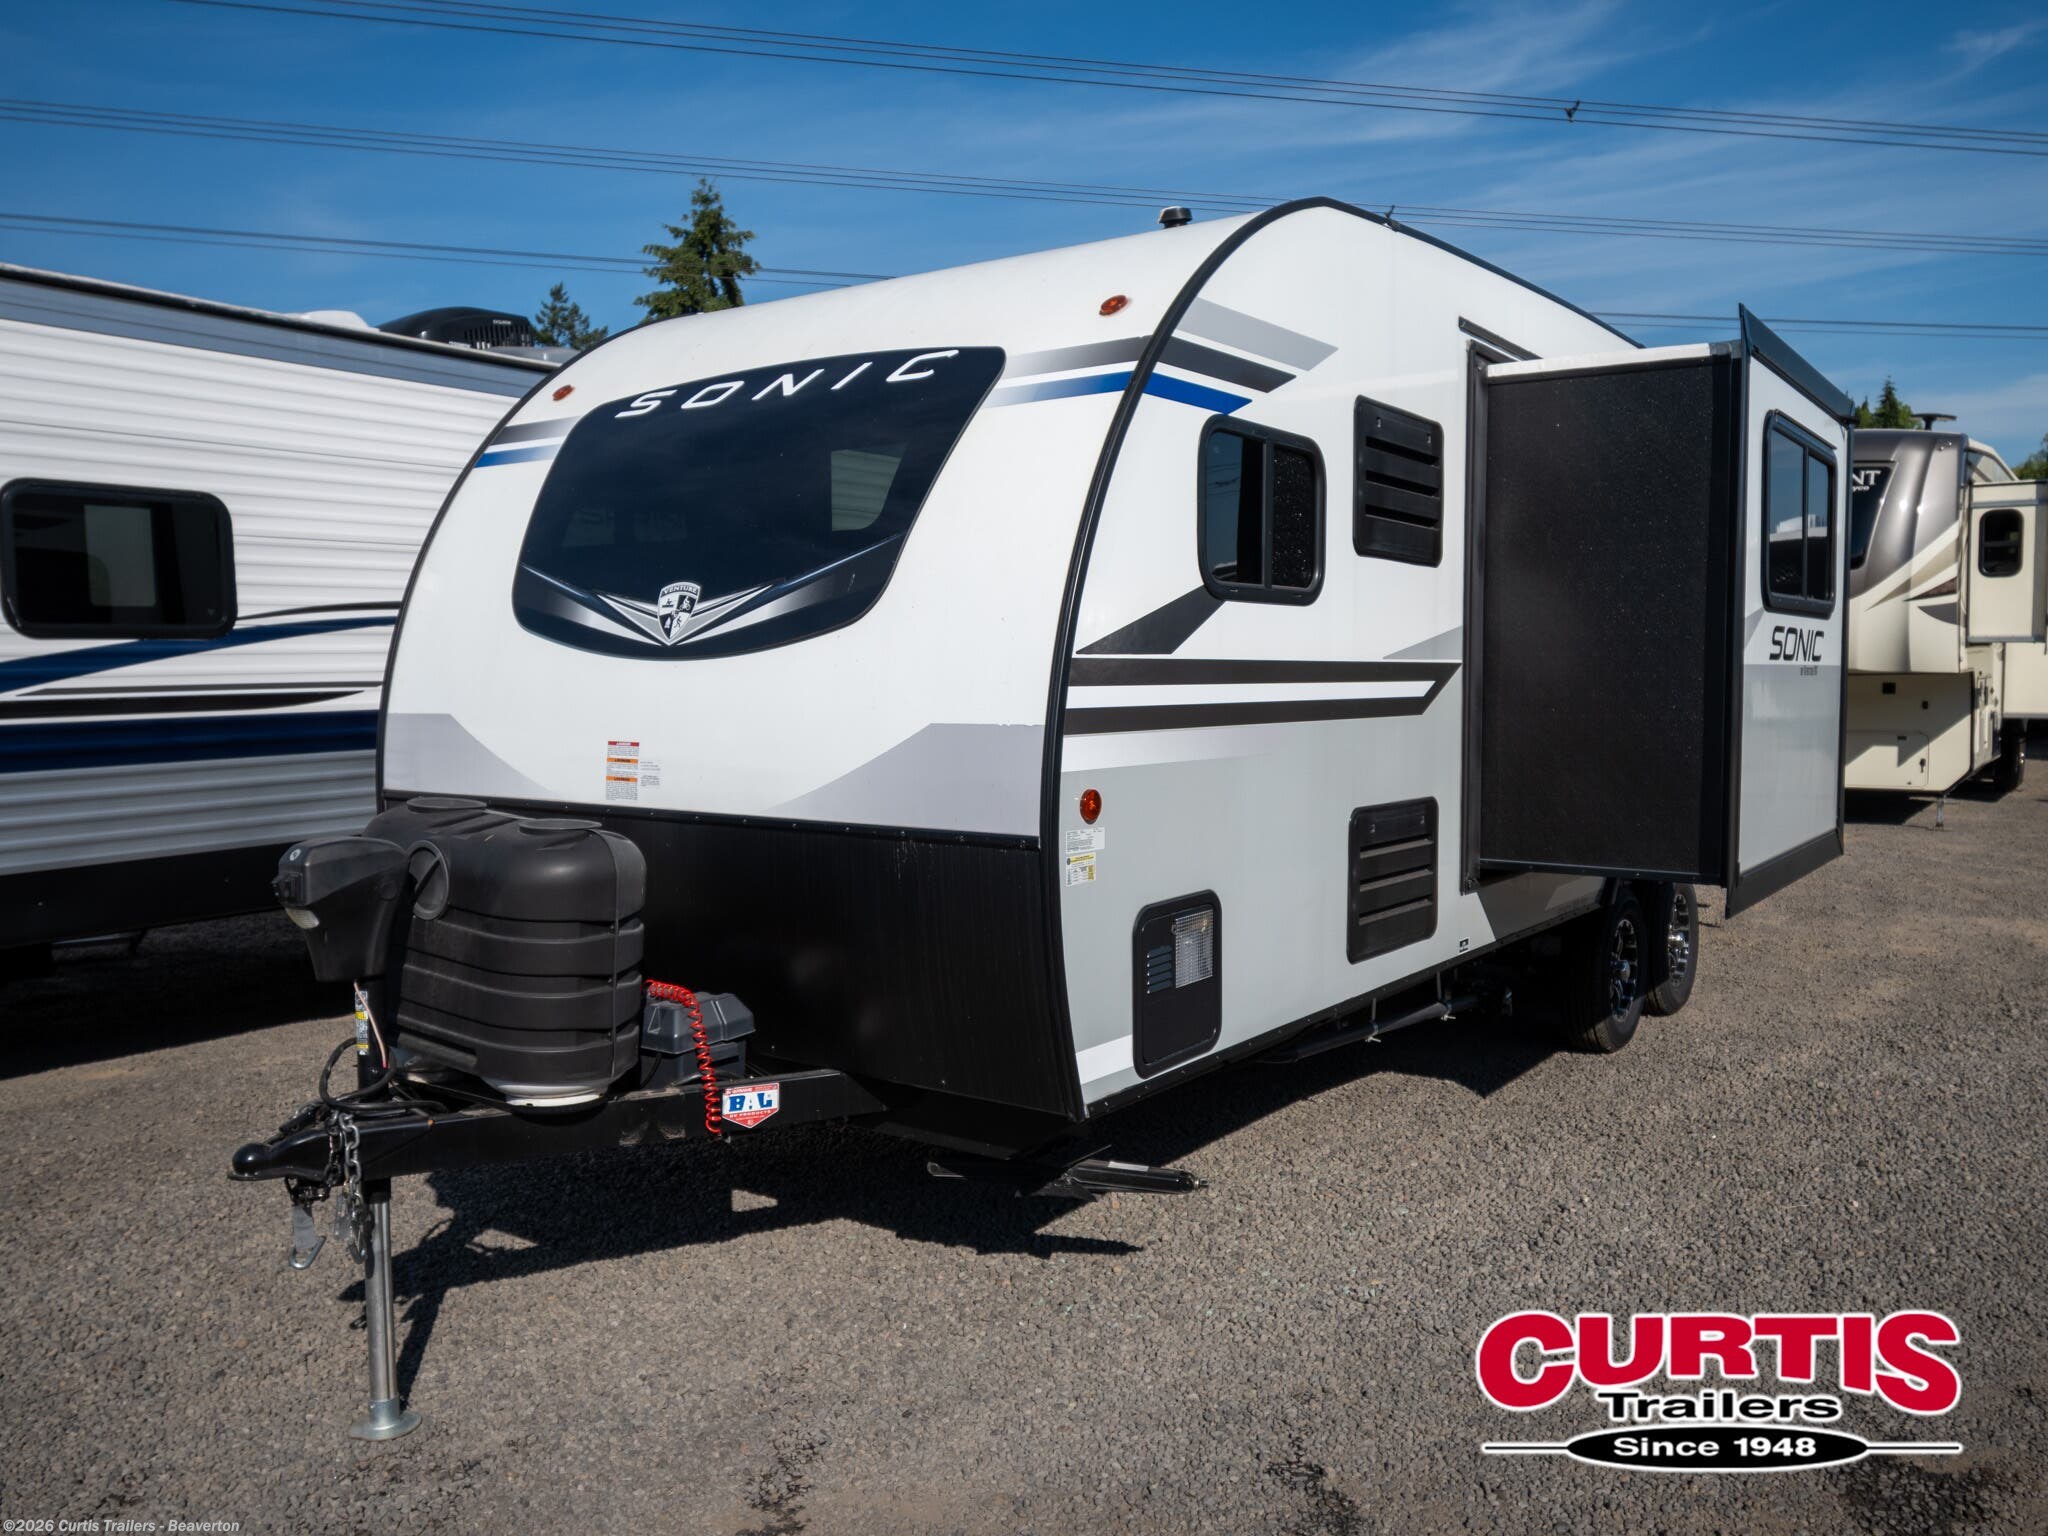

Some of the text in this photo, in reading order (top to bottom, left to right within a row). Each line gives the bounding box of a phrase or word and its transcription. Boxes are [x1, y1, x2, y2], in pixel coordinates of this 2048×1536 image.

[614, 349, 960, 418] SONIC
[1852, 470, 1881, 486] NT
[663, 584, 698, 594] VENTURE
[1769, 625, 1825, 662] SONIC
